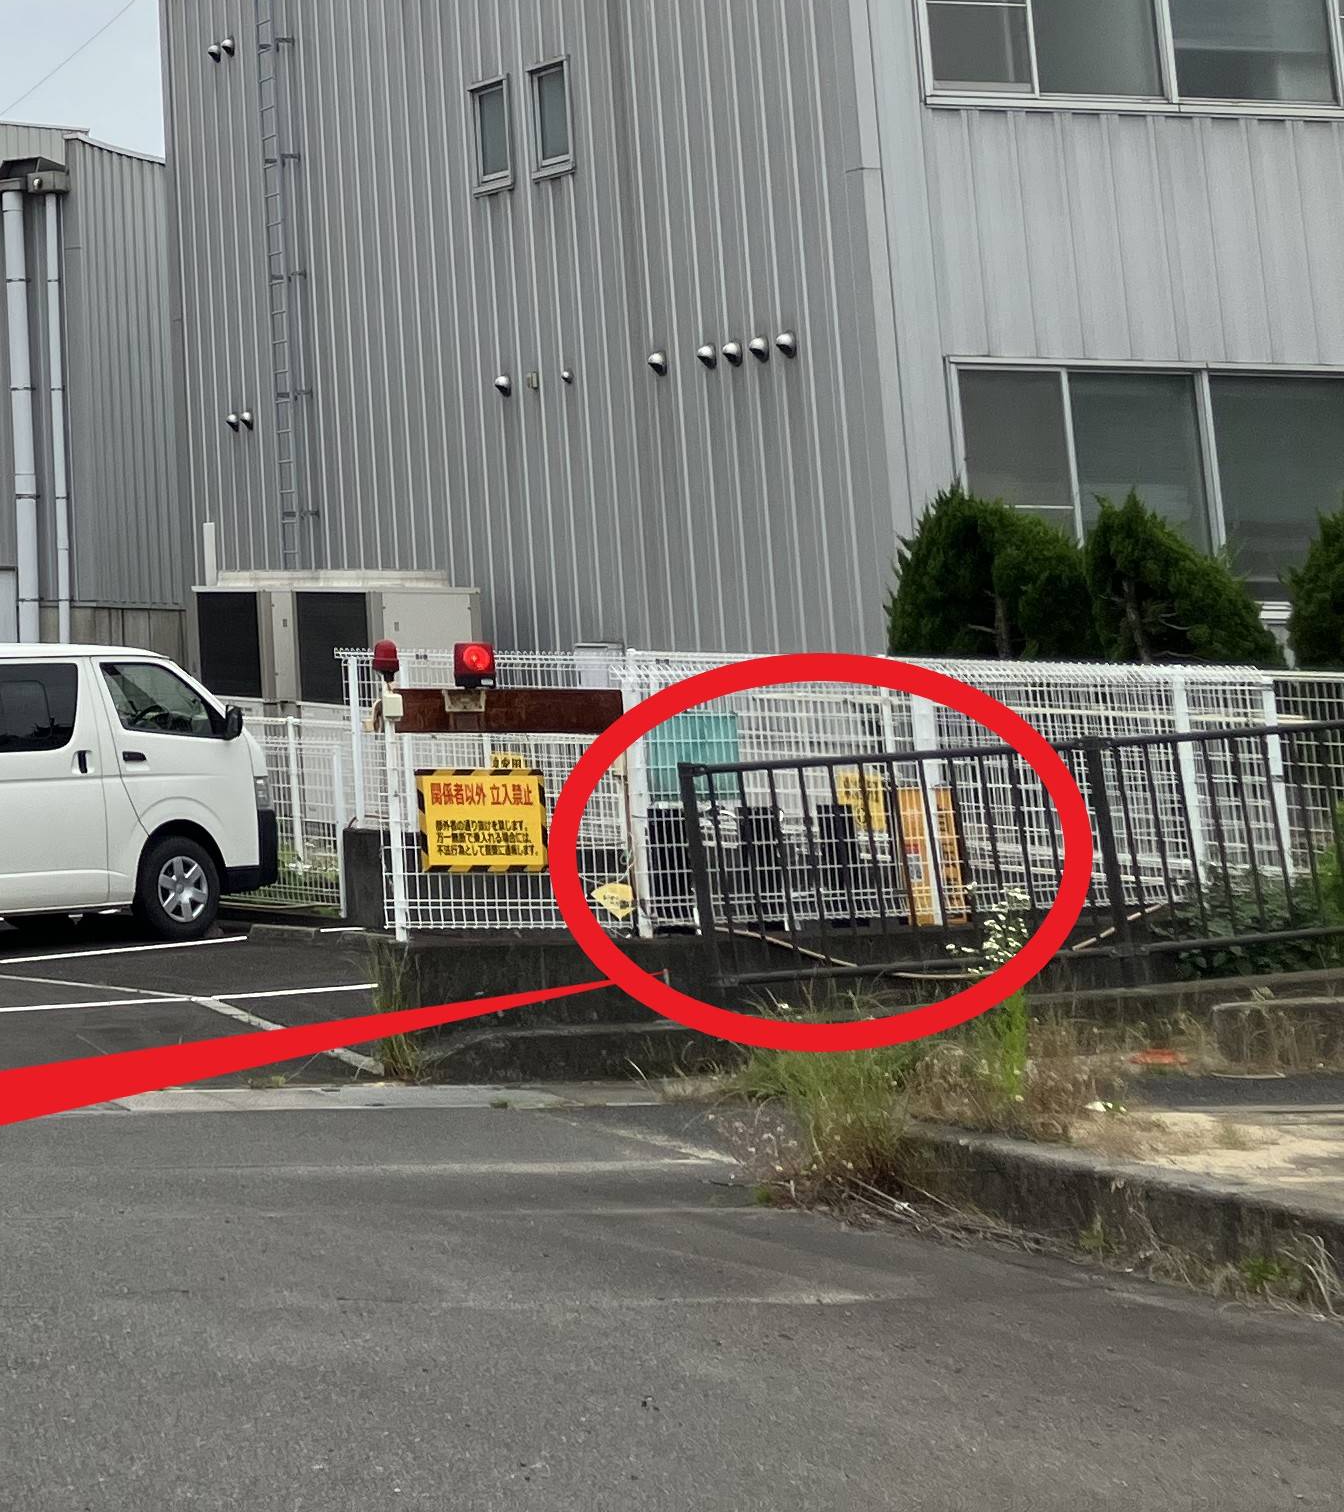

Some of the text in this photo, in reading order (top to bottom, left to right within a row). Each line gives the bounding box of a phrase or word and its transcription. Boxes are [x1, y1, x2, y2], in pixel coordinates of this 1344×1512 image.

[430, 782, 534, 806] 関係者以外 立入禁止
